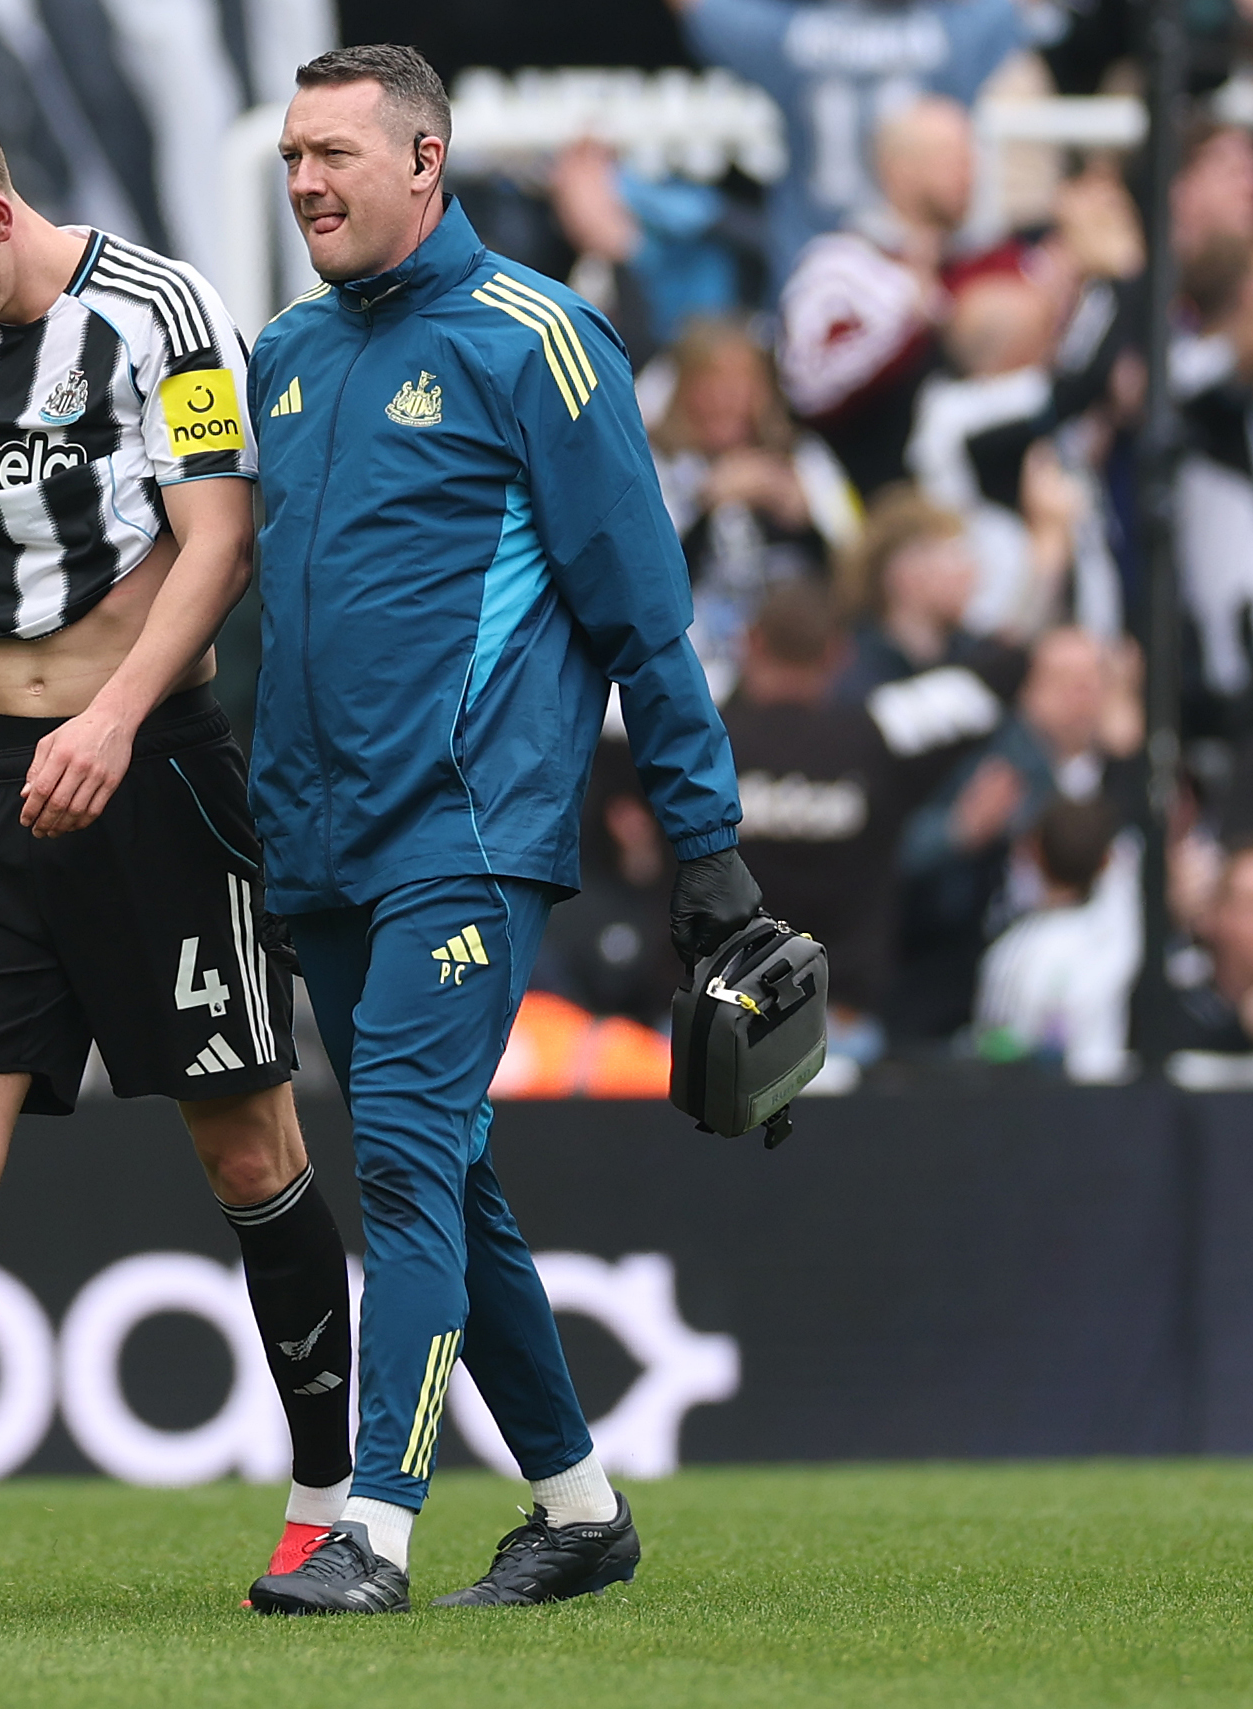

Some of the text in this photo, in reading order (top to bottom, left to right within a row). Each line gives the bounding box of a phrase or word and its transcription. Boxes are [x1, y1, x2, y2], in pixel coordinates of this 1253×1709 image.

[173, 418, 239, 443] noon
[174, 936, 230, 1018] 4
[440, 962, 465, 986] PC
[581, 1530, 603, 1539] COPA
